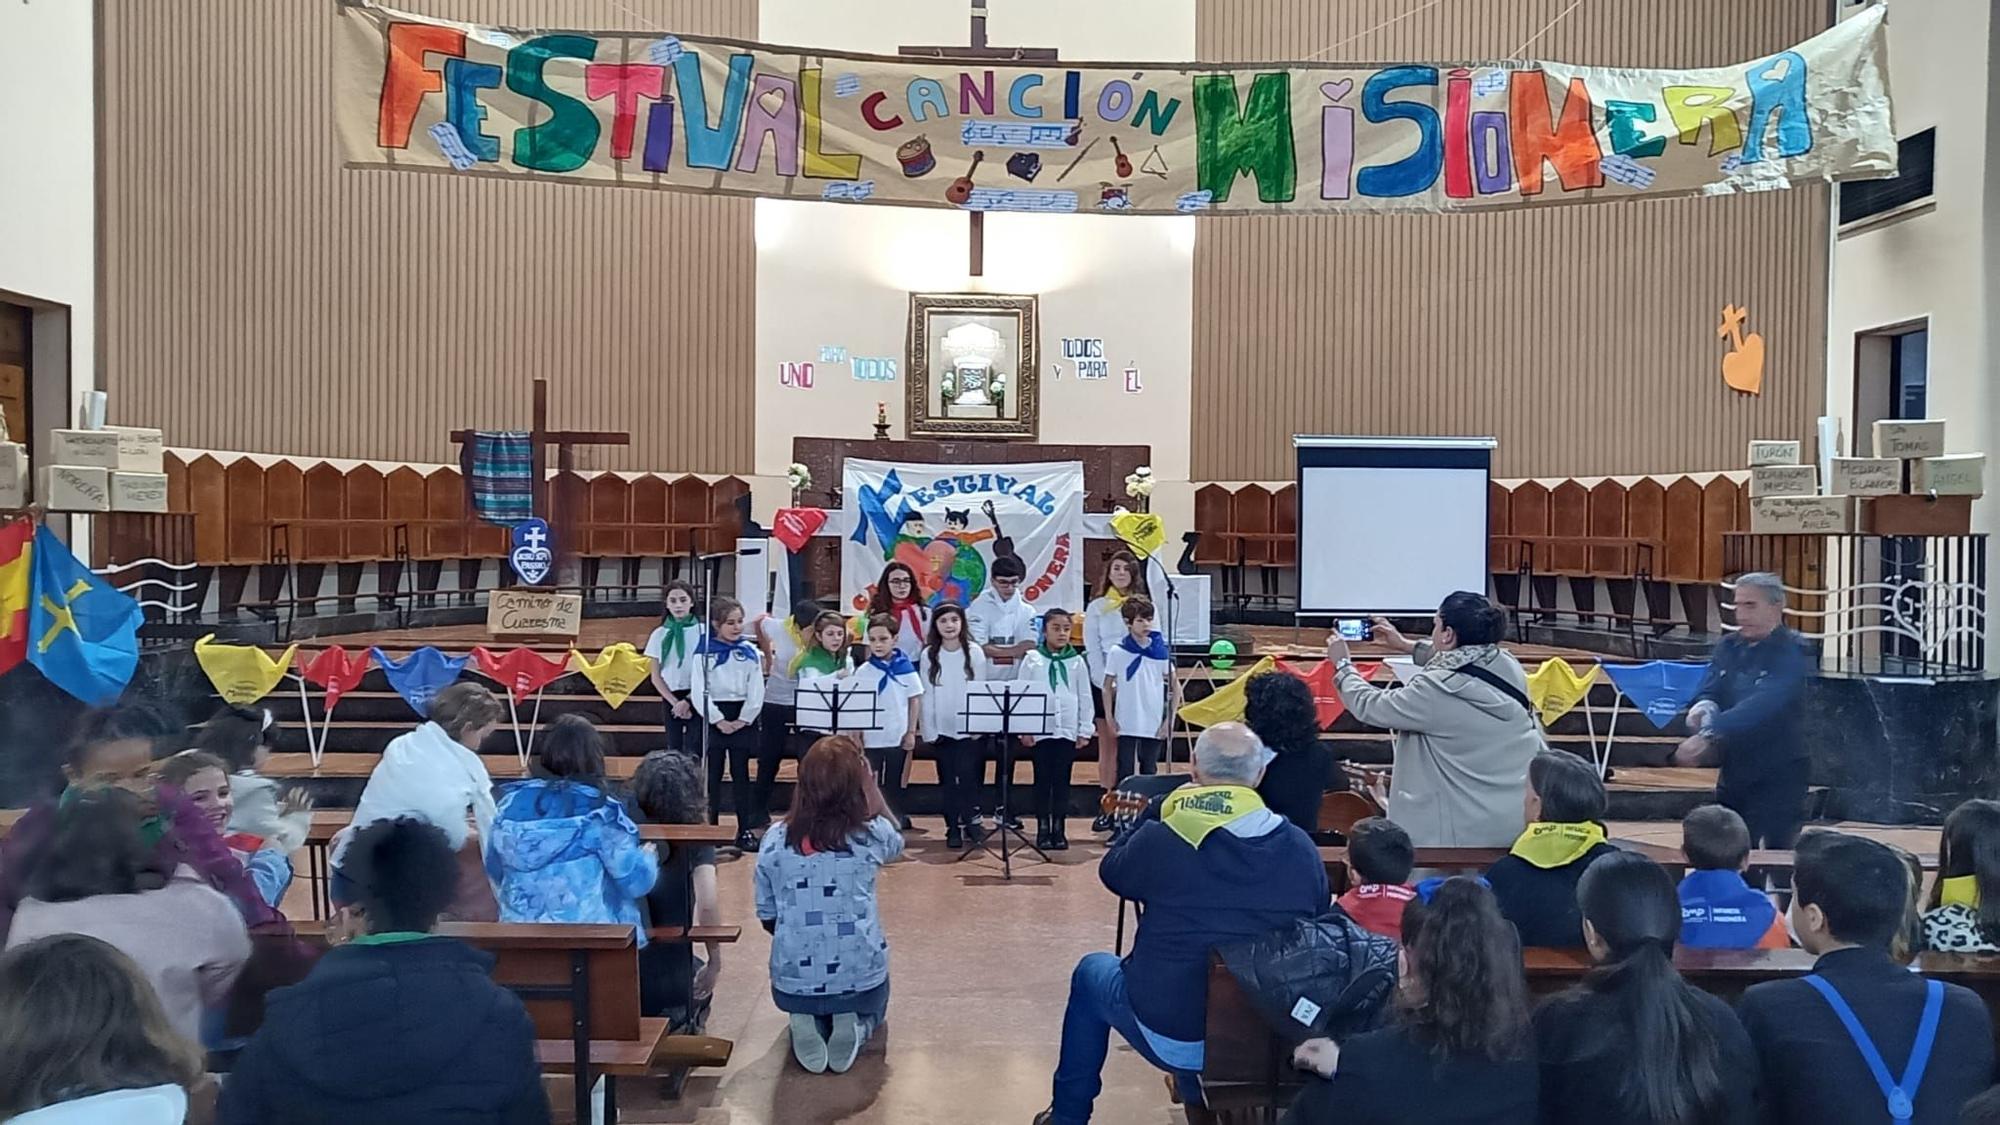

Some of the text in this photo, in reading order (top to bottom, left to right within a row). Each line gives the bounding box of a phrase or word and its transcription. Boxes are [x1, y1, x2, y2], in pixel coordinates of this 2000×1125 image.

[376, 21, 863, 179] FESTIVAL
[859, 69, 1182, 136] CANCIÓN
[1060, 338, 1103, 358] TODOS
[780, 361, 814, 389] UNO
[1078, 361, 1108, 379] PARA
[496, 593, 575, 614] Camino de
[501, 609, 567, 630] Cuaresma
